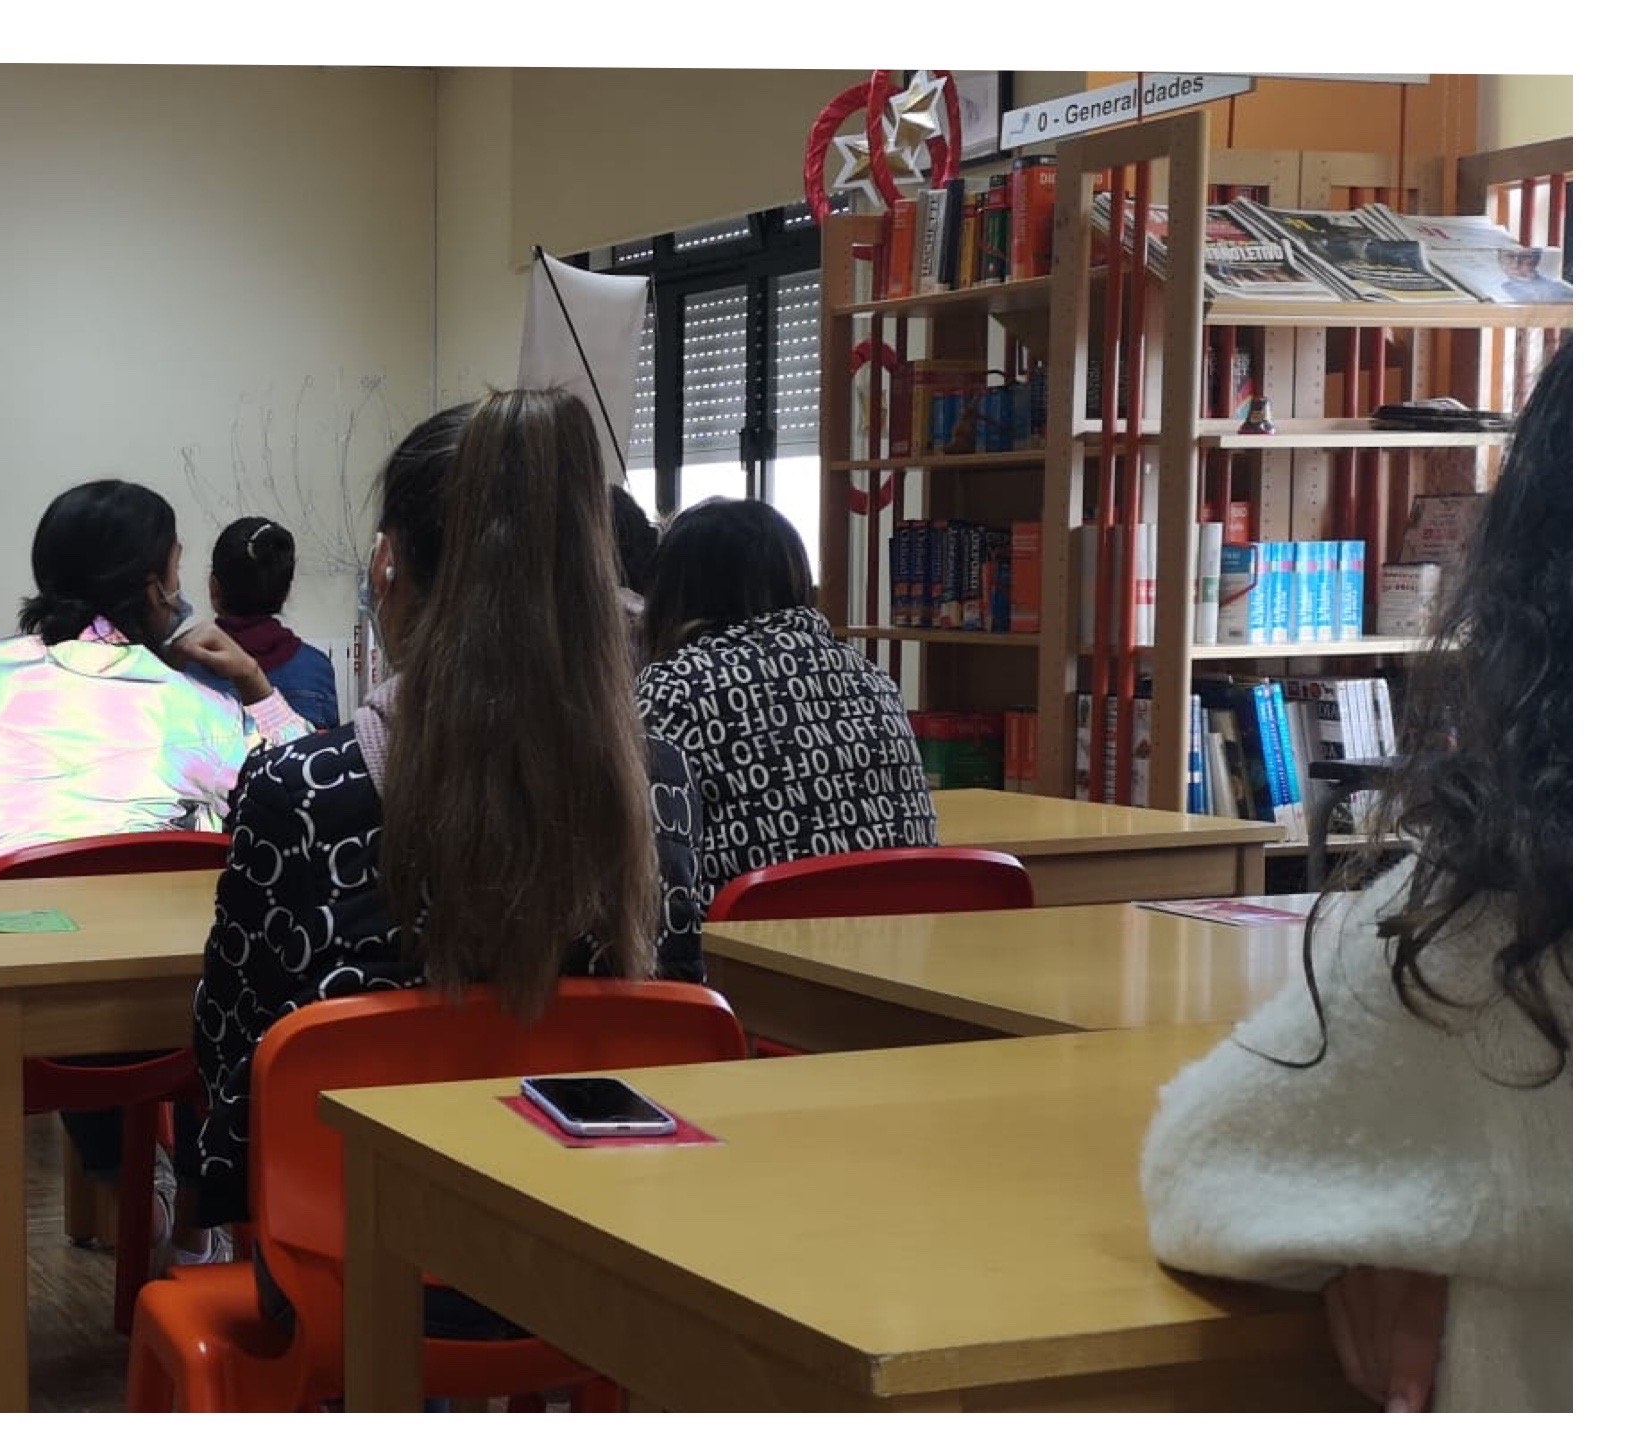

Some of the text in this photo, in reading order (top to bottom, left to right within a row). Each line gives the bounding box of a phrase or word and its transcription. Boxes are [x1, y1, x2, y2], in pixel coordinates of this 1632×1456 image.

[1037, 112, 1048, 132] 0
[1065, 75, 1204, 124] Generaldades
[728, 673, 825, 711] OFF-ON
[794, 696, 876, 723] OFF-ON
[731, 722, 833, 765] OFF-ON
[835, 714, 915, 743] OFF-ON
[834, 738, 910, 771] OFF-ON
[726, 749, 830, 797] OFF-ON
[813, 766, 895, 802] OFF-ON
[754, 801, 858, 841] OFF-ON
[860, 791, 930, 823] OFF-ON
[748, 829, 851, 870] OFF-ON
[855, 818, 928, 850] OFF-ON
